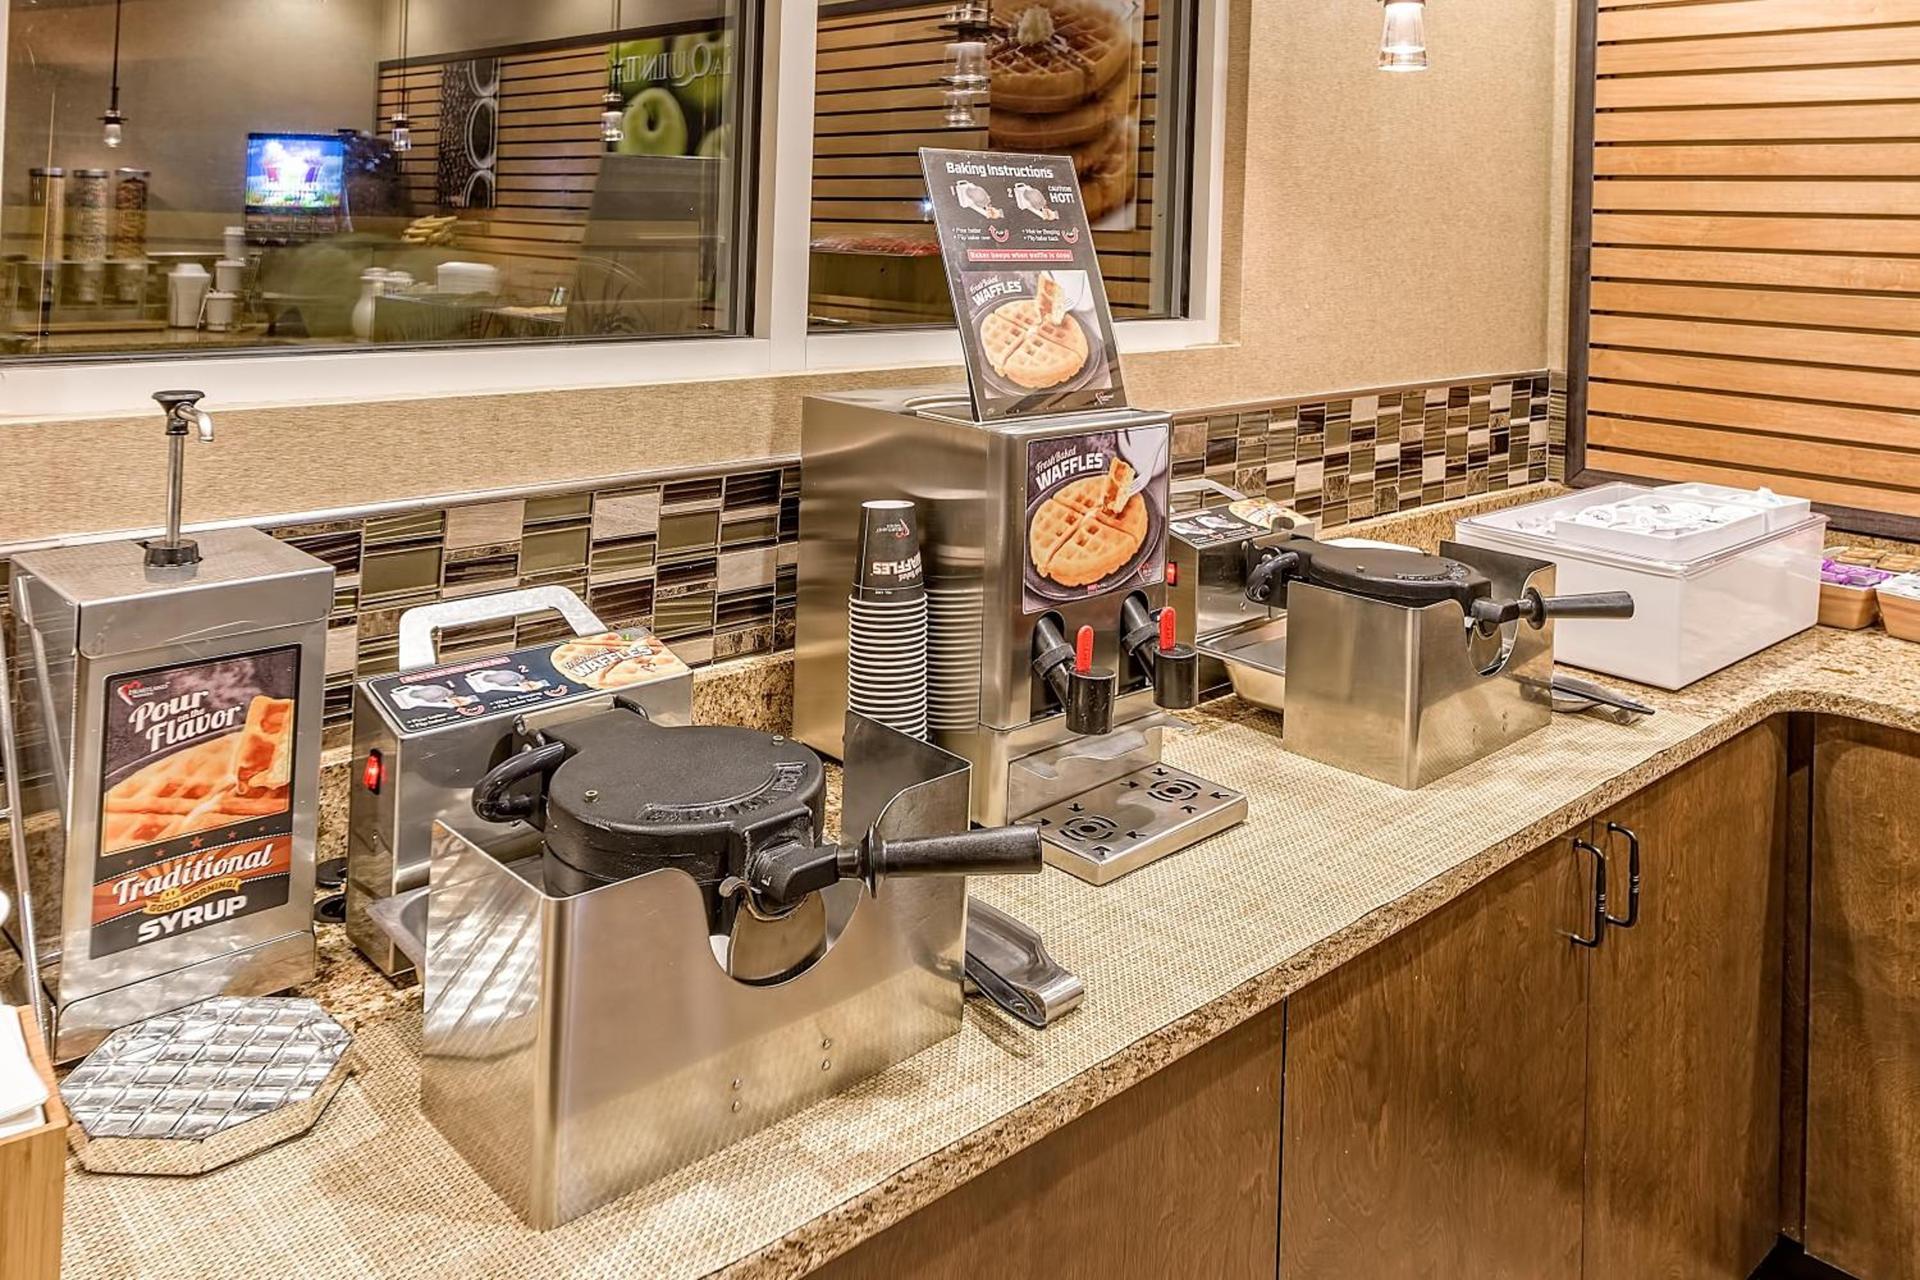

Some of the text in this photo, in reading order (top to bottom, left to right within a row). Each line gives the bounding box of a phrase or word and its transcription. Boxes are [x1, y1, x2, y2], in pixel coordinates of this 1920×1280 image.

[945, 161, 1054, 178] Baking Instructions
[1049, 192, 1075, 203] HOT!
[972, 281, 1022, 306] WAFFLES
[1035, 452, 1104, 491] WAFFLES
[573, 645, 653, 677] WAFFLES
[128, 690, 209, 734] Pour
[145, 705, 242, 752] Flavor
[177, 708, 205, 722] on the
[112, 843, 273, 905] Traditional
[149, 879, 238, 913] GOOD MORNING!
[137, 895, 247, 943] SYRUP
